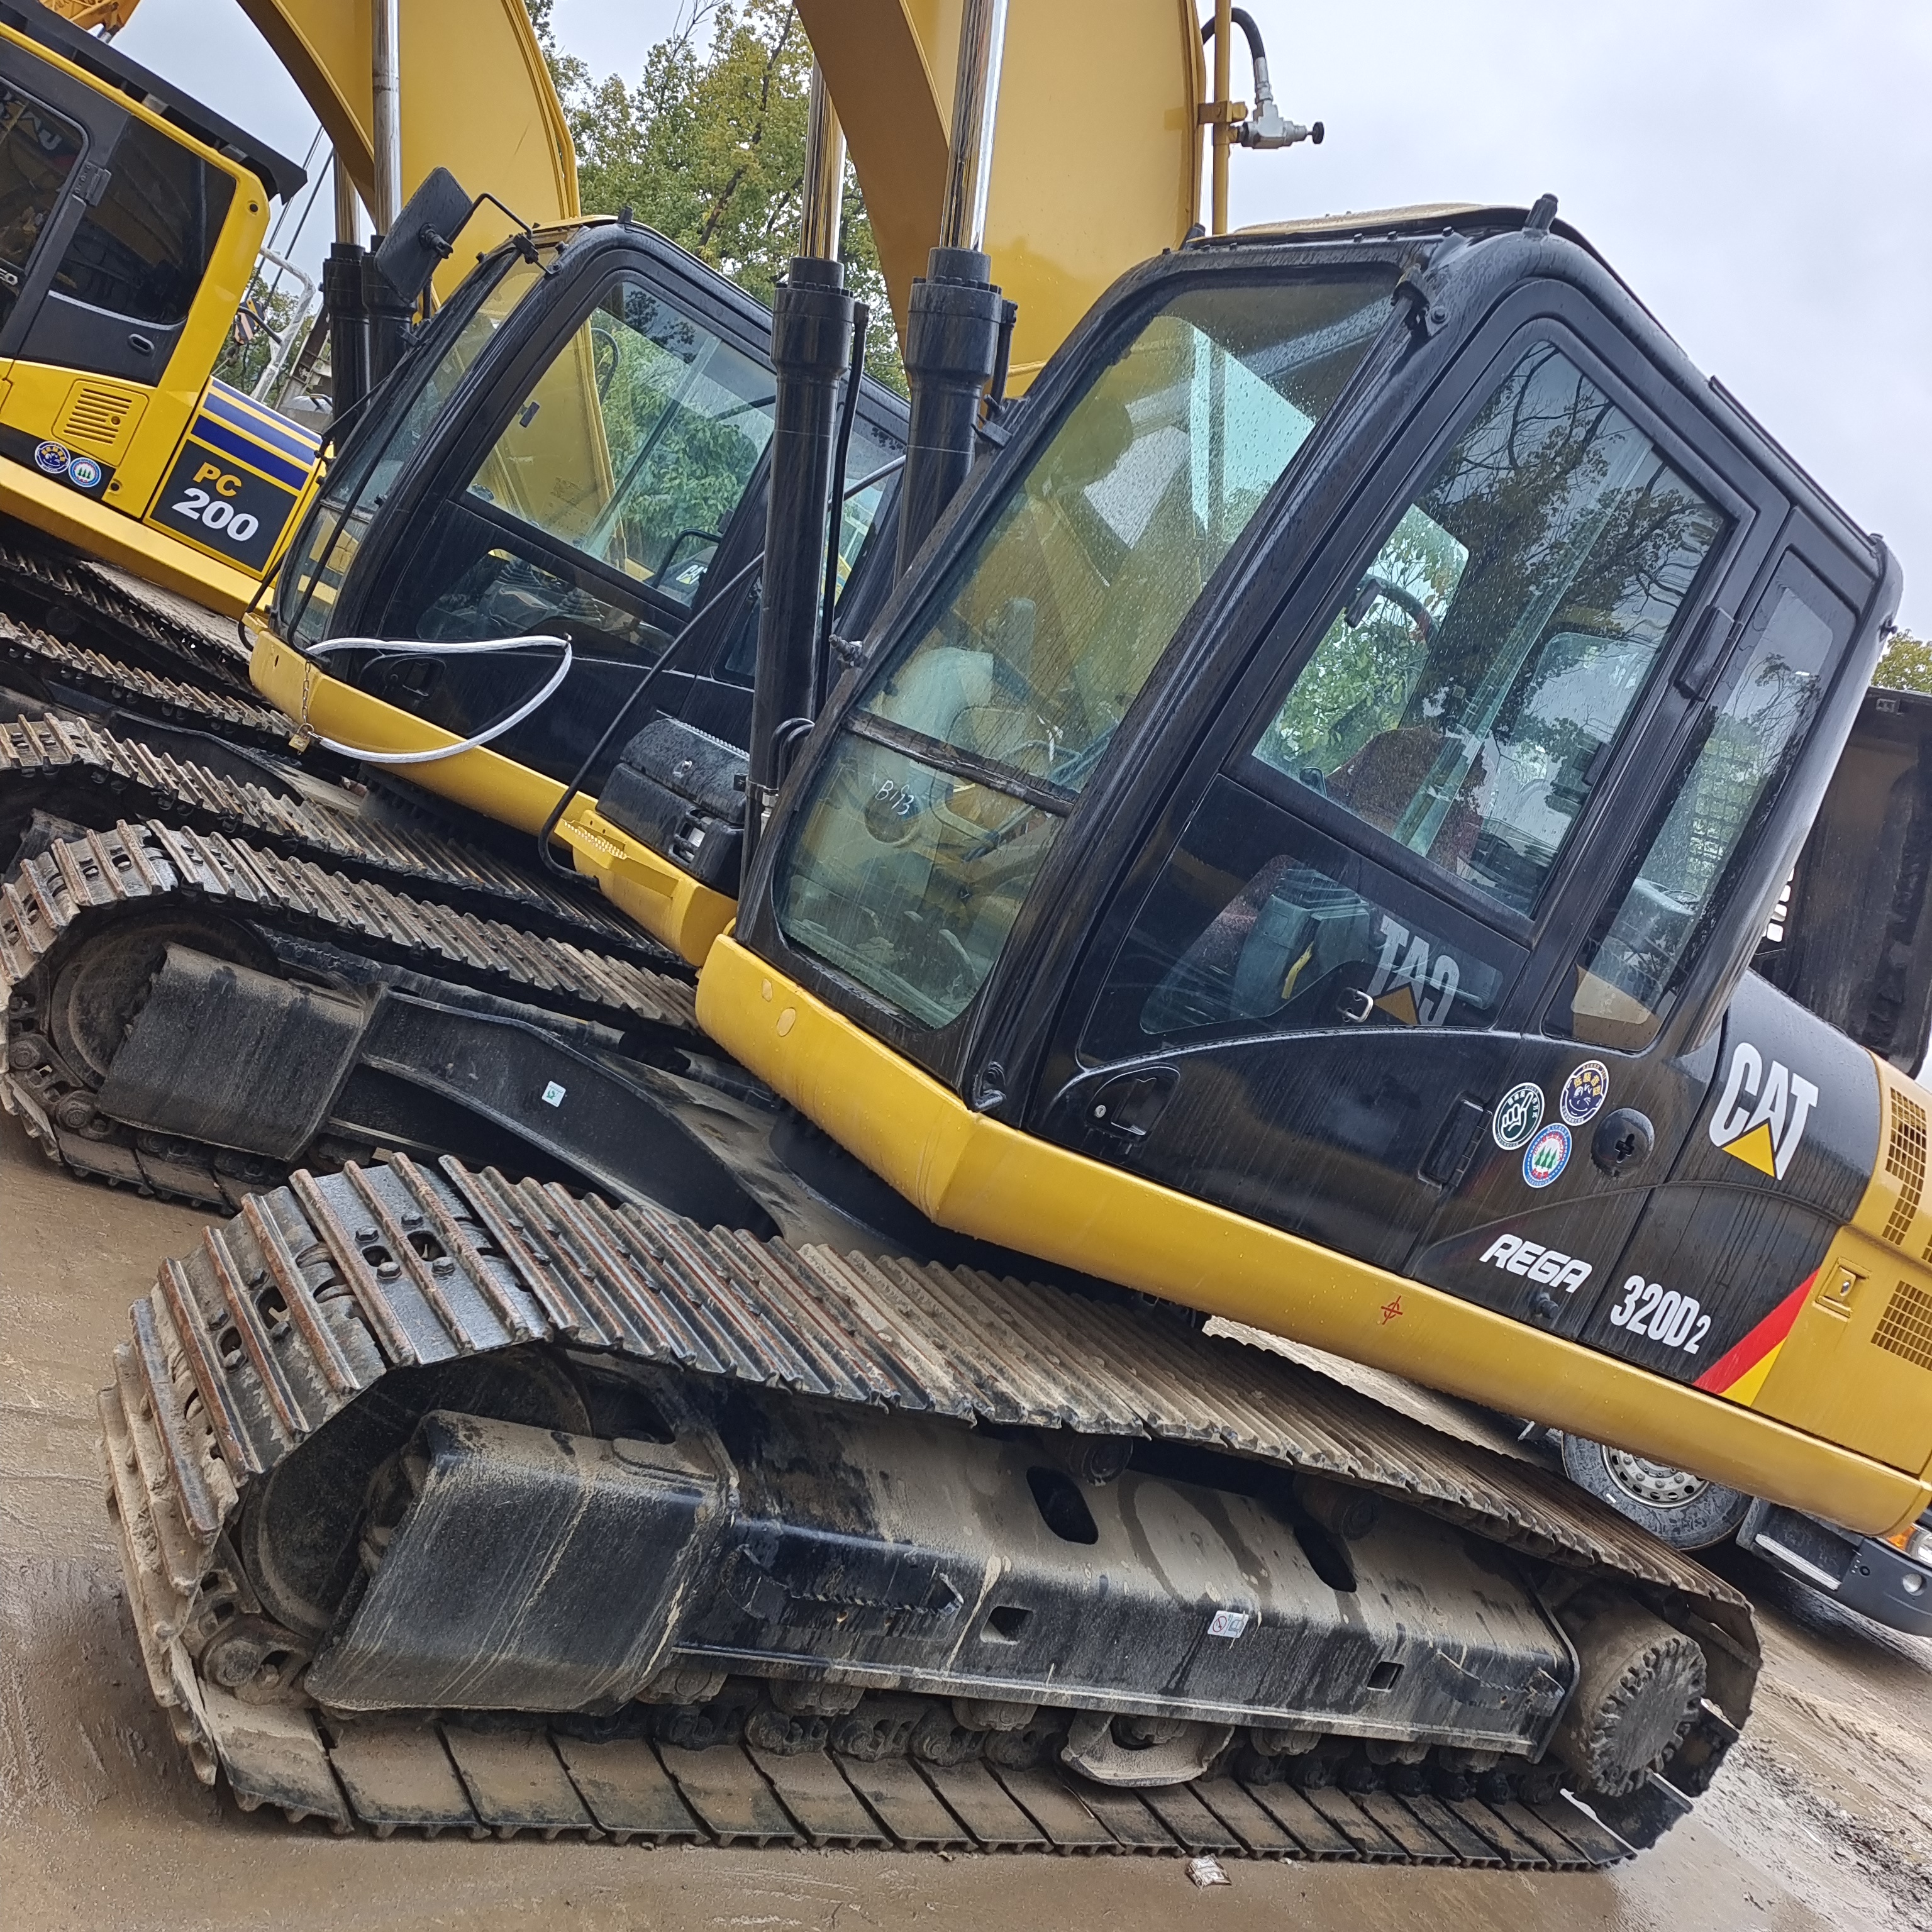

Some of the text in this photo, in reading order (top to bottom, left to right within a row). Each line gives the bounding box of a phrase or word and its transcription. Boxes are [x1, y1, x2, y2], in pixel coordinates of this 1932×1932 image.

[192, 462, 242, 497] PC
[171, 487, 259, 541] 200
[1709, 1041, 1819, 1180] CAT
[1479, 1233, 1593, 1294] REGA
[1610, 1275, 1711, 1355] 320D2
